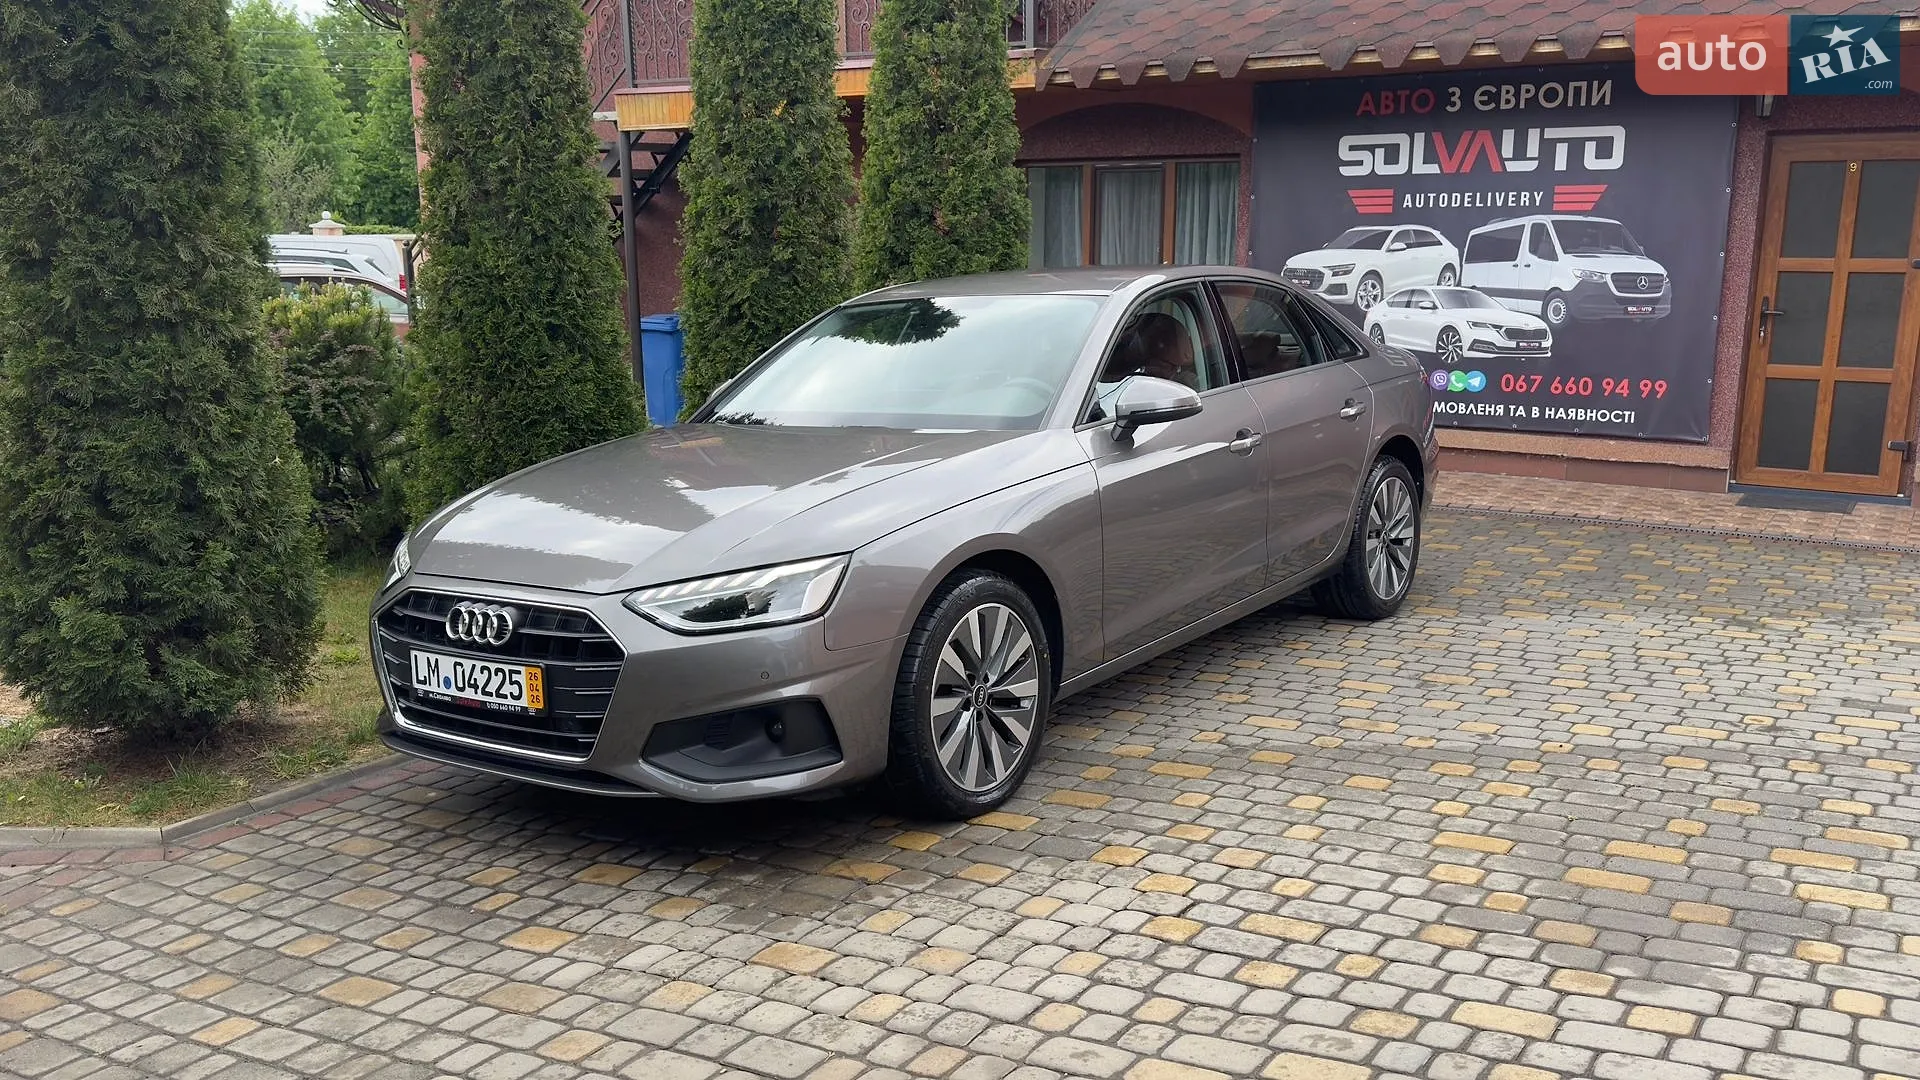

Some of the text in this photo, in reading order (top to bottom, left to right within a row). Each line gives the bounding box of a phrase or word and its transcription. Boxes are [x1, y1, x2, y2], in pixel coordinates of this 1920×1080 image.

[1356, 88, 1436, 116] АВТО
[1474, 80, 1613, 111] ЄВРОПИ
[1338, 125, 1626, 176] SOLVAUTO
[1850, 162, 1857, 172] 9
[1402, 191, 1544, 208] AUTODELIVERY
[1501, 373, 1668, 399] 067 660 94 99
[1508, 404, 1527, 418] ТА
[1531, 406, 1539, 419] В
[1545, 406, 1635, 423] НАЯВНОСТІ
[413, 654, 523, 702] LM 04225
[528, 671, 539, 681] 26
[529, 683, 540, 692] 04
[530, 694, 541, 703] 26
